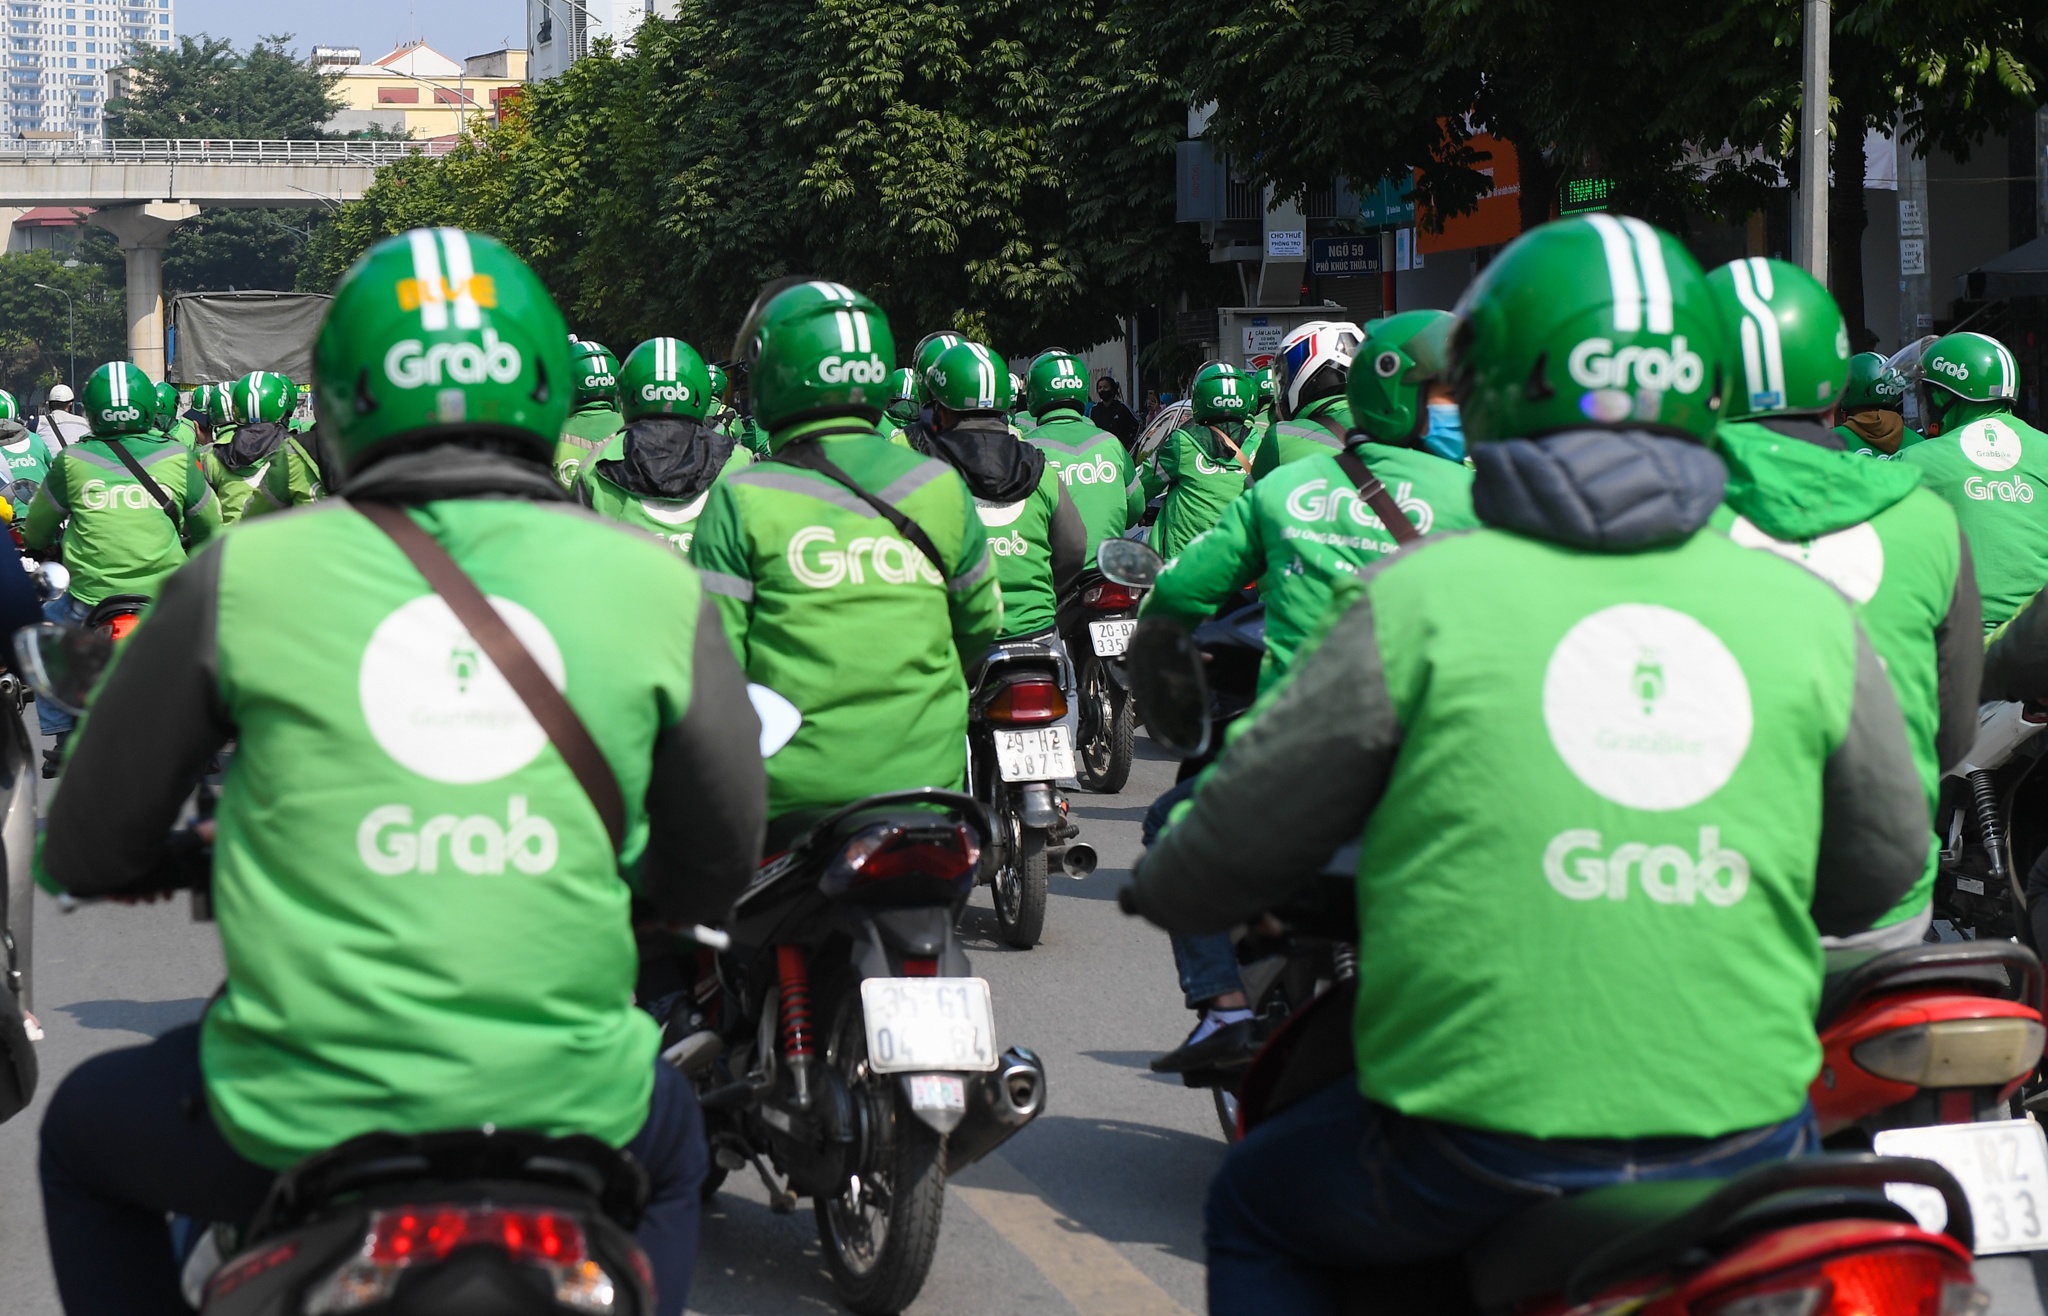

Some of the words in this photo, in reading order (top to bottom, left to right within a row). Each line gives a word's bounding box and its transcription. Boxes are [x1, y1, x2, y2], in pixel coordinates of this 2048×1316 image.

[1285, 231, 1302, 239] THUÊ
[1328, 242, 1349, 258] NGÕ
[1351, 244, 1364, 257] 59
[1316, 259, 1330, 272] PHỐ
[1330, 258, 1349, 271] KHÚC
[384, 328, 522, 389] Grab
[1568, 334, 1704, 394] Grab
[818, 354, 886, 384] Grab
[1931, 356, 1969, 381] Grab
[585, 373, 615, 387] Grab
[1051, 375, 1083, 390] Grab
[1260, 380, 1275, 389] Gr
[641, 381, 690, 401] Grab
[1875, 383, 1900, 396] Gra
[1212, 395, 1243, 409] Grab
[101, 406, 140, 422] Grab
[8, 454, 37, 469] Grab
[1964, 475, 2034, 504] Grab
[1286, 478, 1434, 535] Grab
[986, 529, 1028, 557] ab
[1097, 638, 1125, 653] 335
[356, 794, 559, 876] Grab
[1542, 825, 1750, 907] Grab
